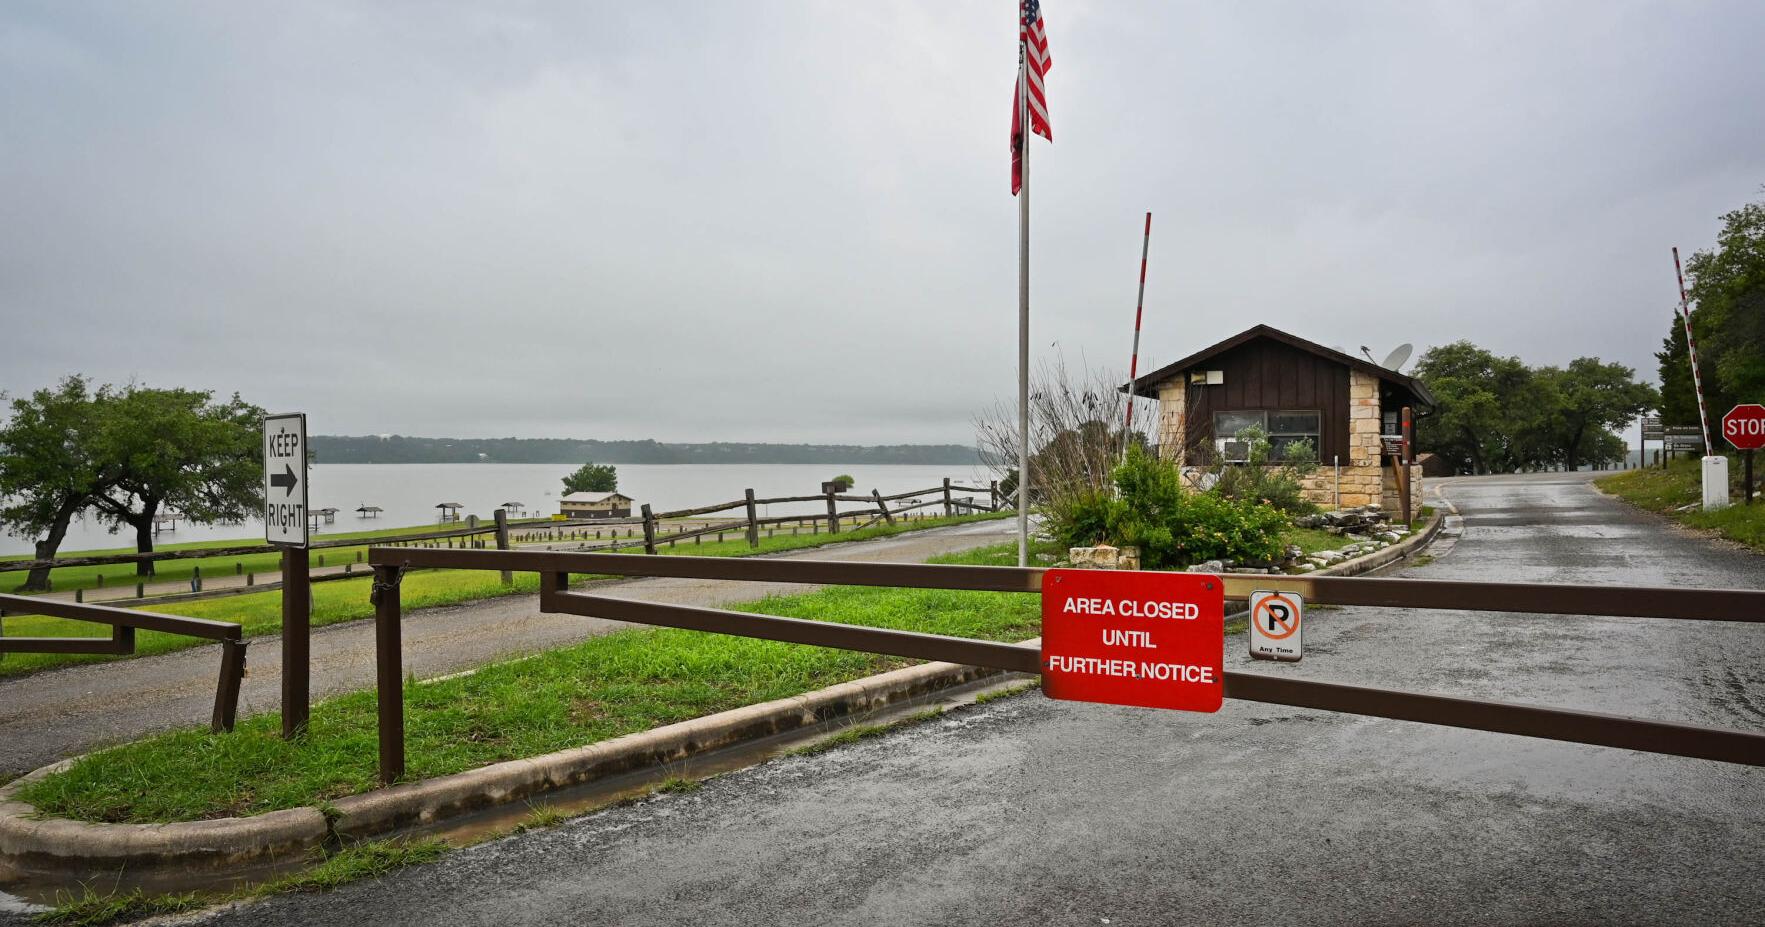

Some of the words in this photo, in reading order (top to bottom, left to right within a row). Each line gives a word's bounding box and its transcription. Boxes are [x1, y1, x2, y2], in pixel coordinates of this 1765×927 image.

[269, 433, 299, 458] KEEP
[268, 503, 303, 528] RIGHT
[1063, 597, 1115, 616] AREA
[1119, 599, 1199, 620] CLOSED
[1102, 629, 1157, 649] UNTIL
[1259, 646, 1273, 654] Any
[1049, 655, 1137, 678] FURTHER
[1141, 662, 1214, 684] NOTICE
